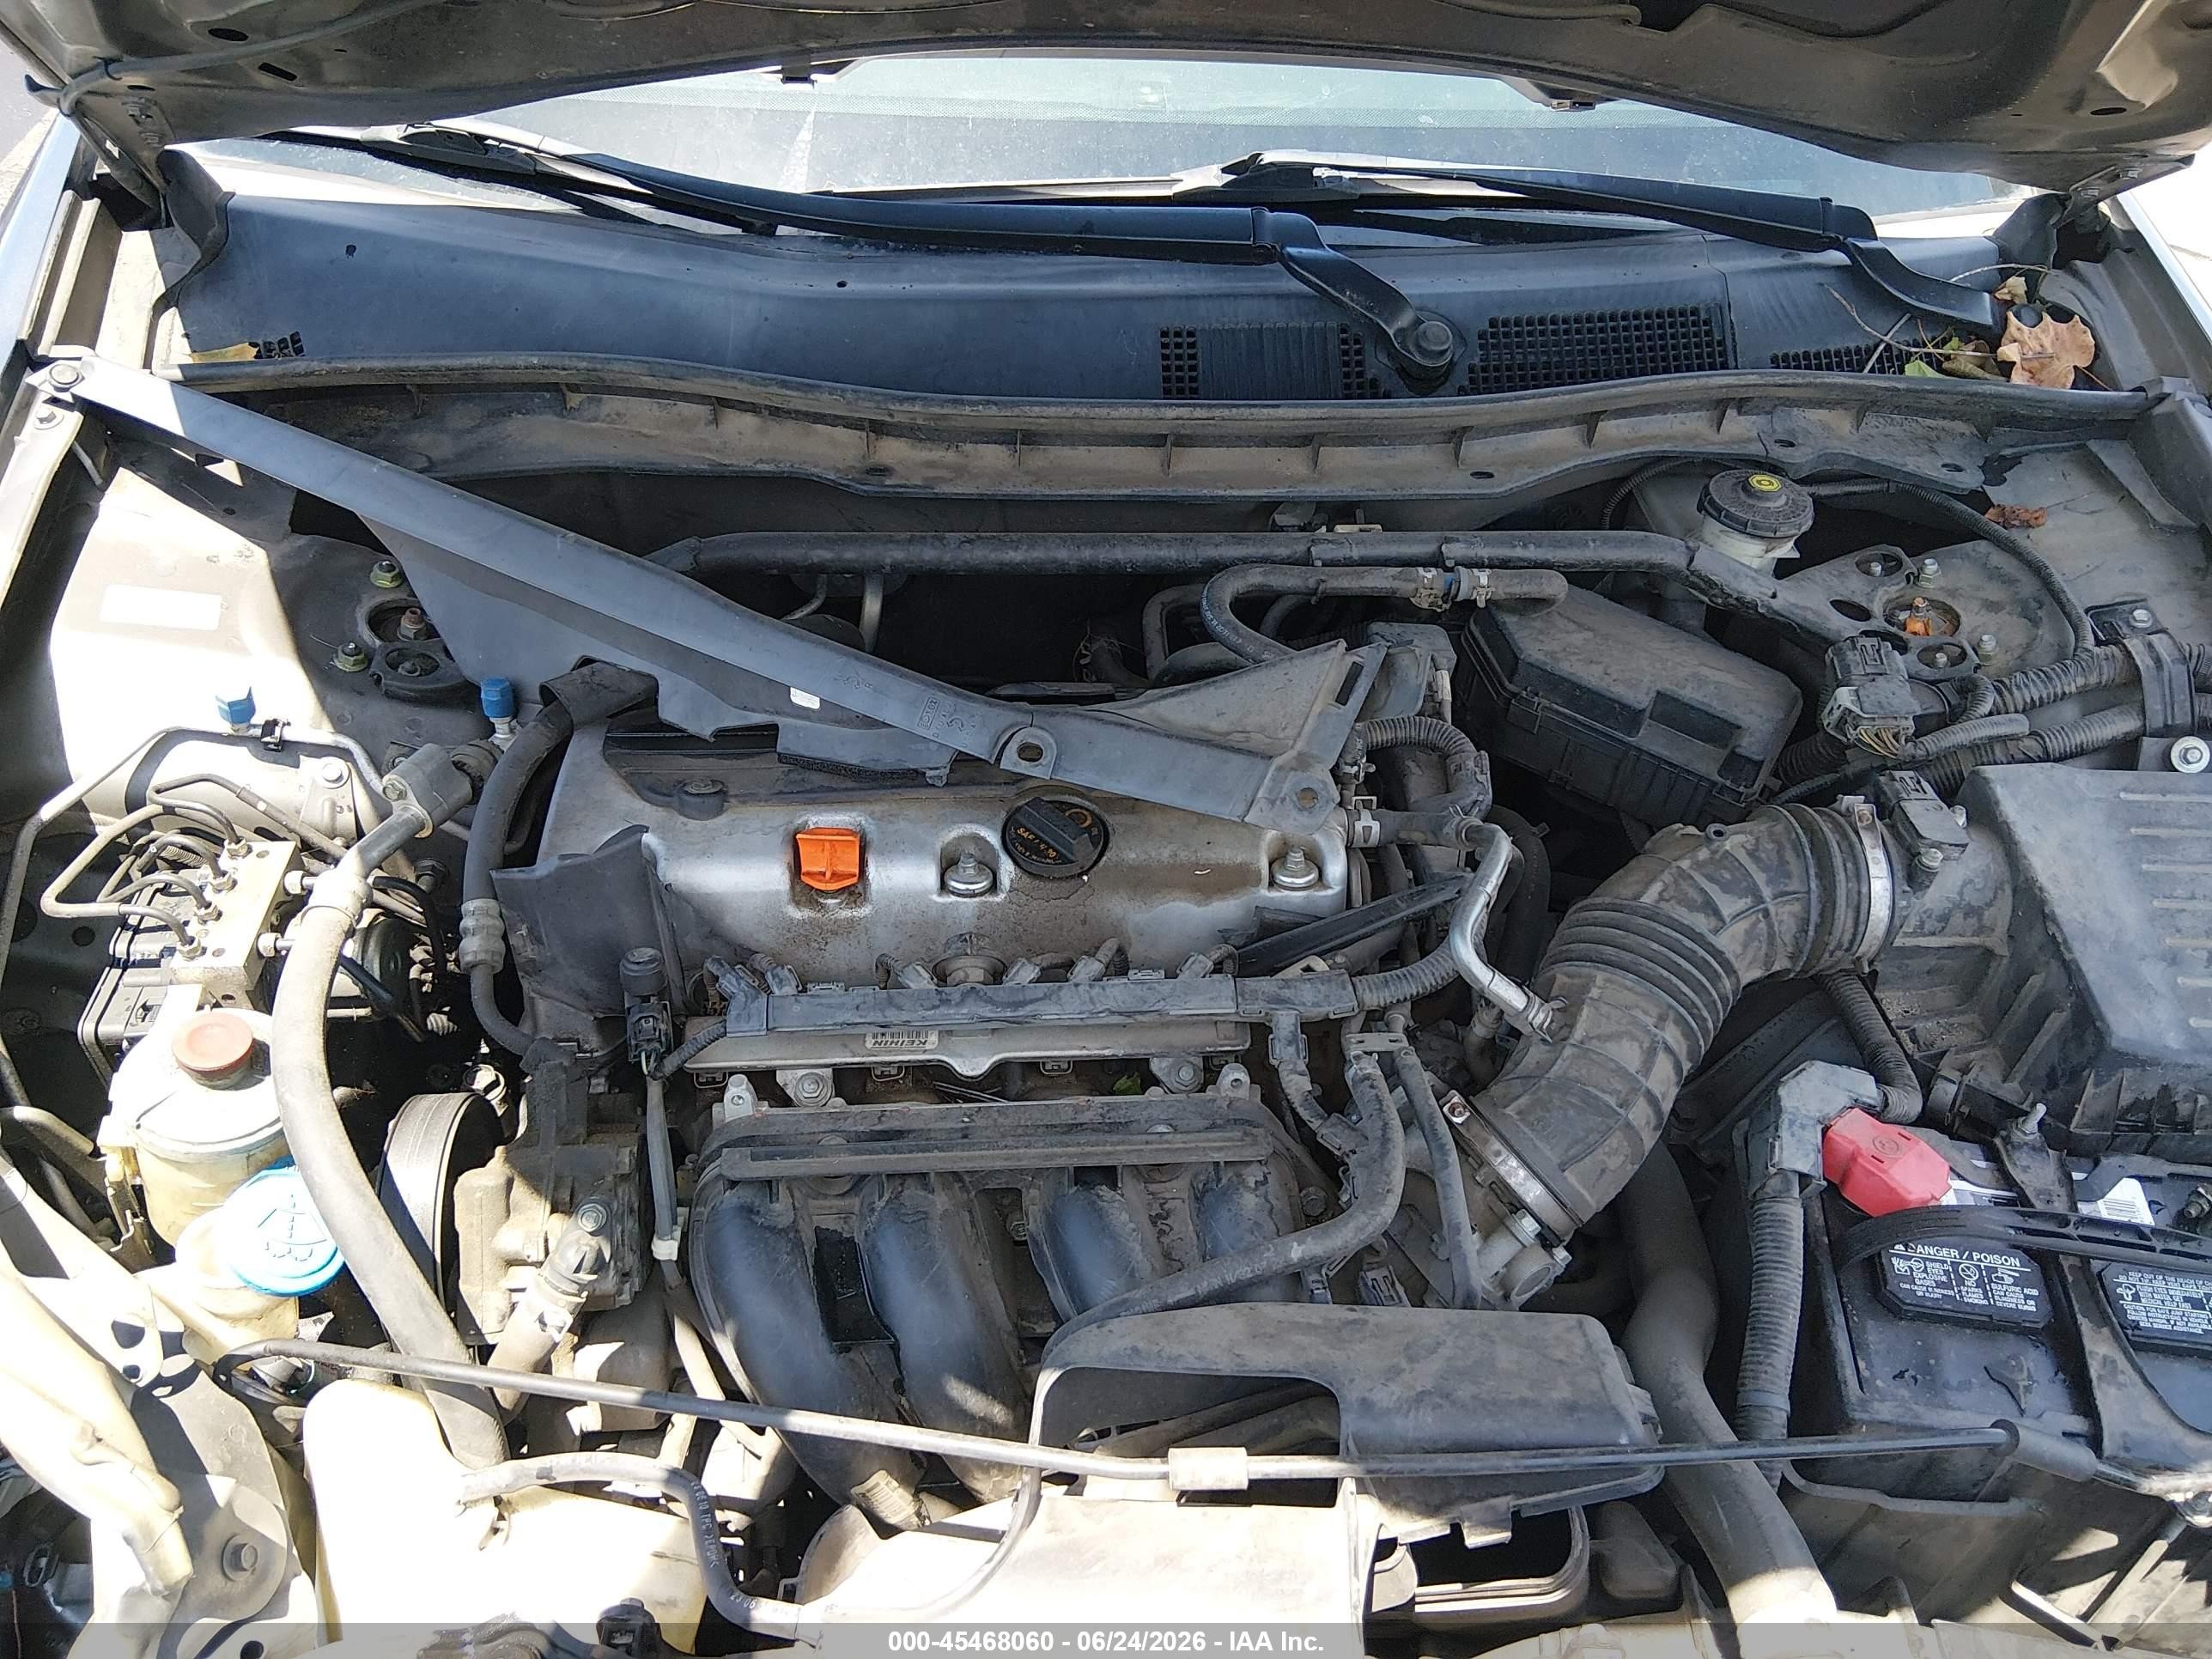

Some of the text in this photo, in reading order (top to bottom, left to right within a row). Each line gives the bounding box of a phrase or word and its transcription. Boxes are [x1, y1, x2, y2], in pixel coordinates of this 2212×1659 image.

[1972, 1252, 2021, 1267] POISON
[1925, 1261, 1948, 1270] SHIELD
[1913, 1273, 1948, 1282] EXPLOSIVE
